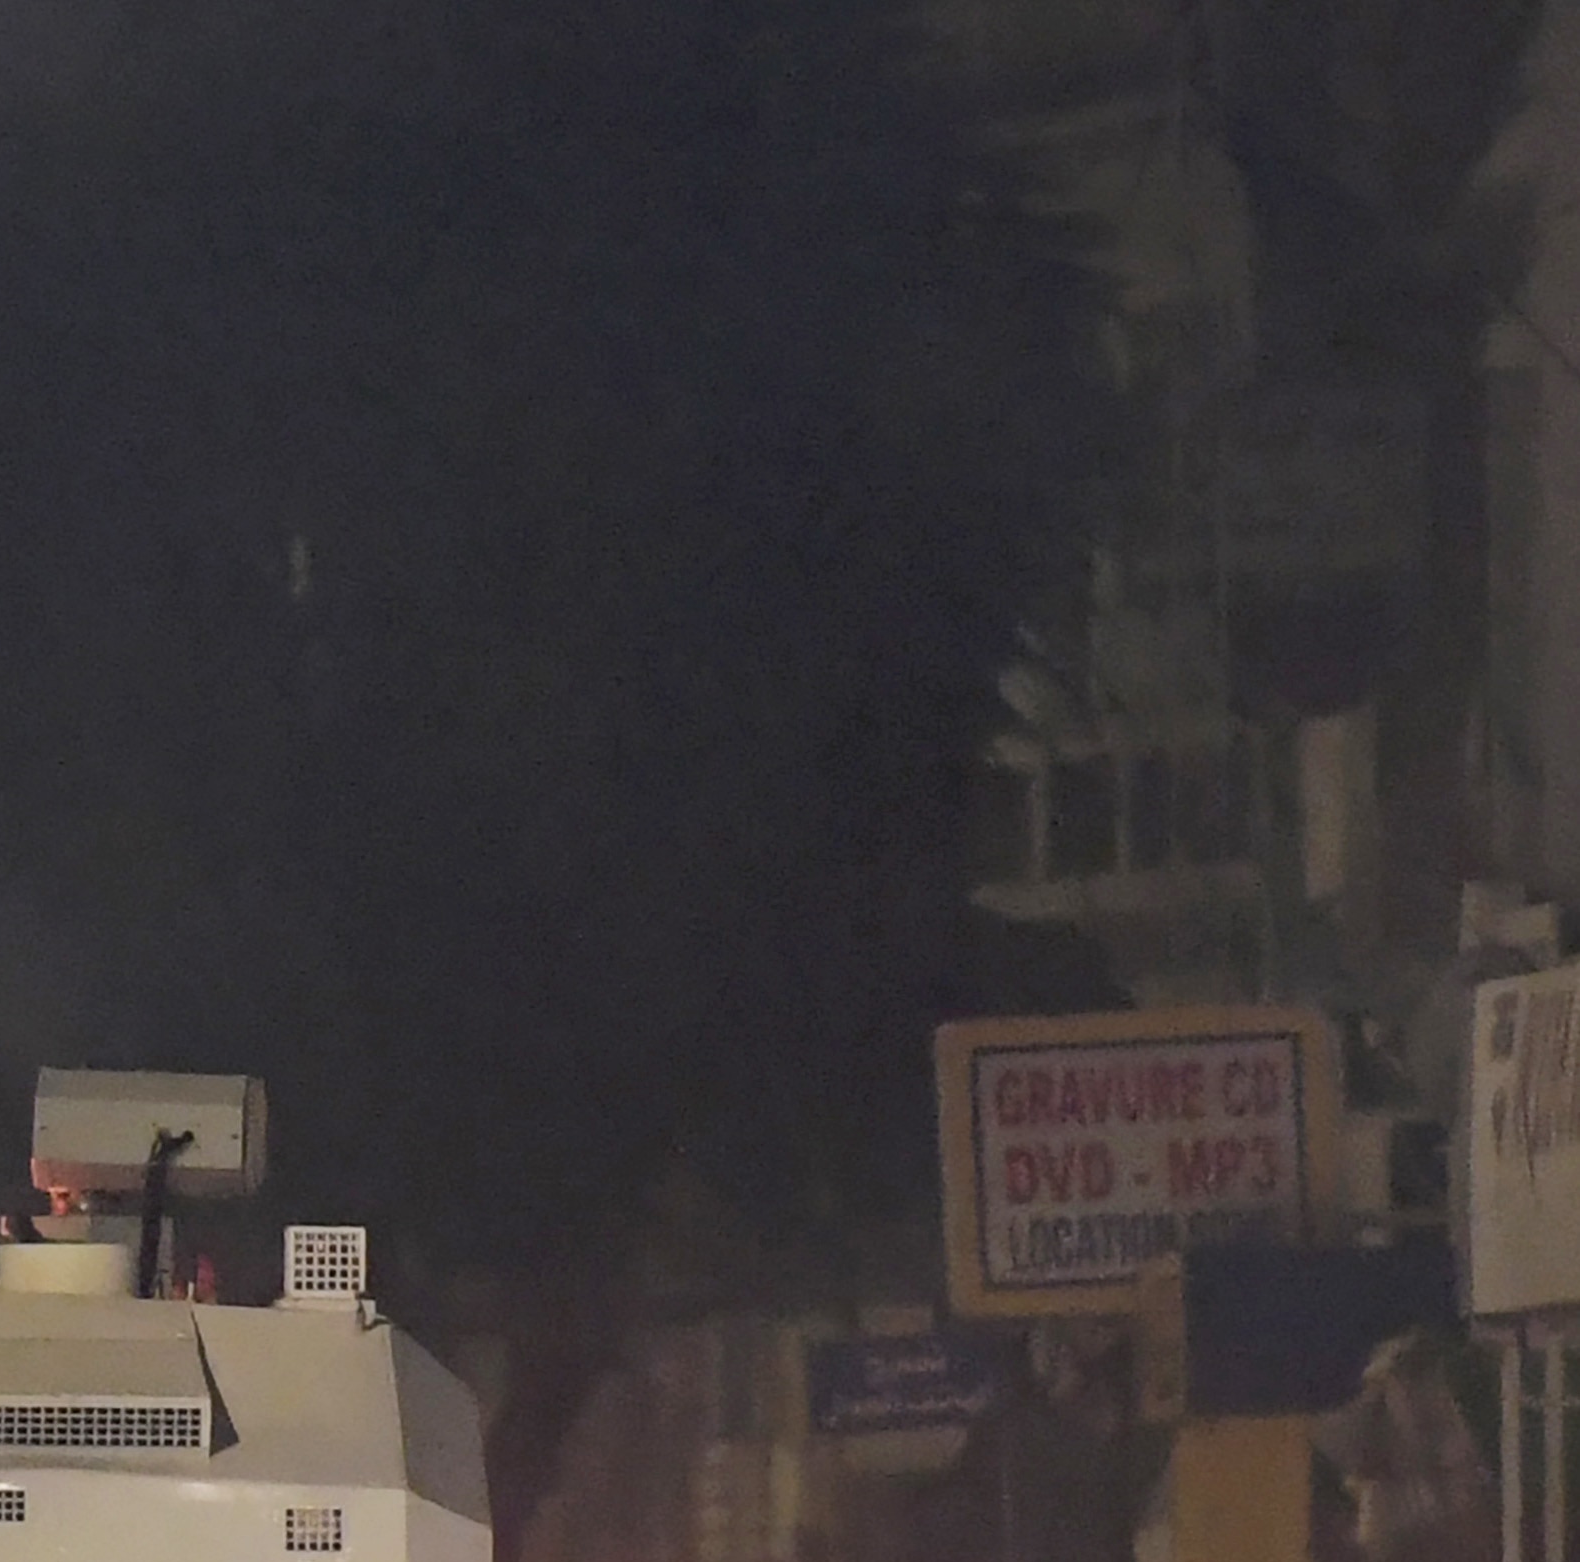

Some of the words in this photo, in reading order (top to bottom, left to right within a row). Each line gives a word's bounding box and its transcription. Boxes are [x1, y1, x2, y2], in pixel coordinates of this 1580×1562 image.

[995, 1062, 1207, 1127] GRAVURE
[1004, 1140, 1114, 1205] DVD
[1167, 1132, 1279, 1198] MP3
